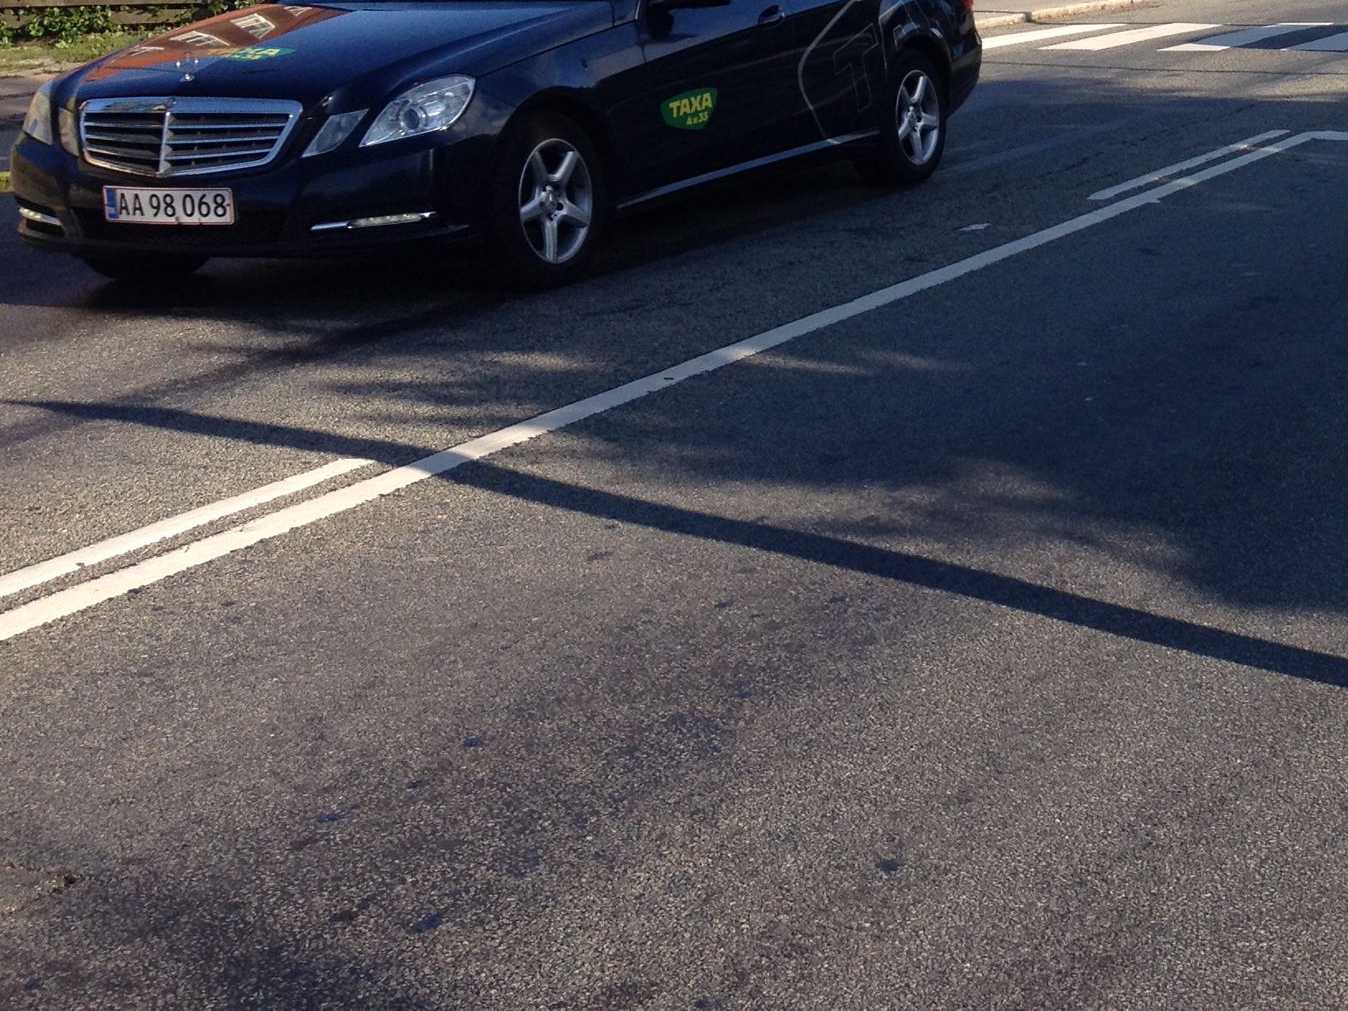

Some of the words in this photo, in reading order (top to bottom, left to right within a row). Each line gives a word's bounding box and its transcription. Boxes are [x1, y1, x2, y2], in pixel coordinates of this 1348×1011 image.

[668, 92, 713, 118] TAXA
[118, 192, 145, 216] AA
[149, 193, 176, 218] 98
[182, 193, 227, 218] 068
